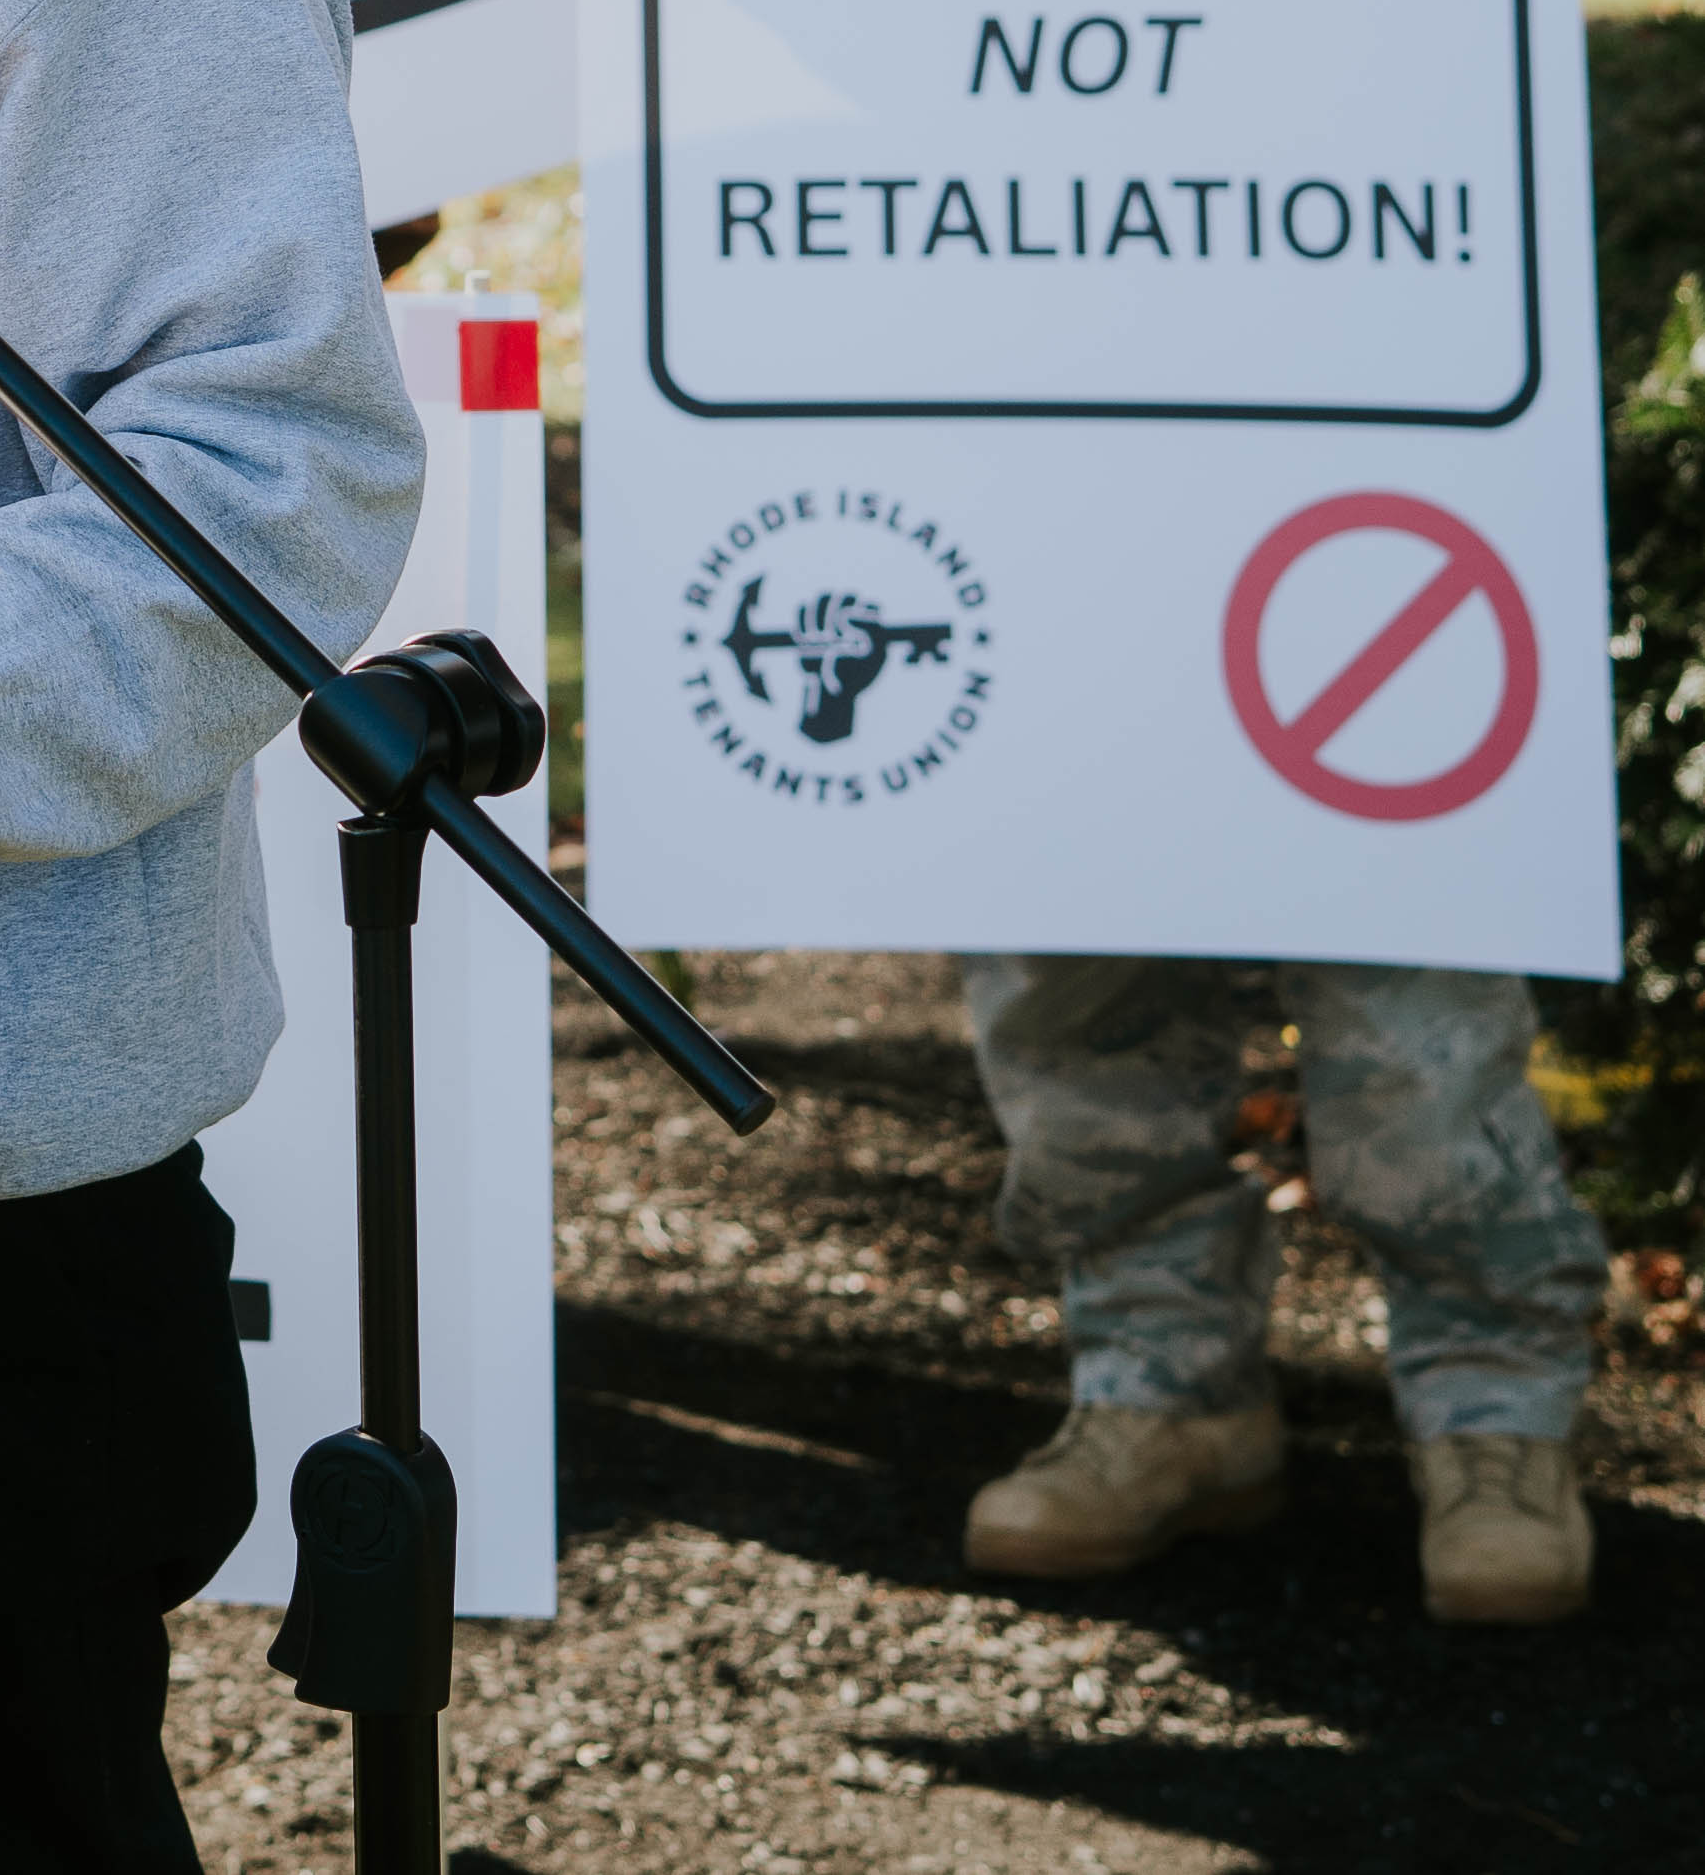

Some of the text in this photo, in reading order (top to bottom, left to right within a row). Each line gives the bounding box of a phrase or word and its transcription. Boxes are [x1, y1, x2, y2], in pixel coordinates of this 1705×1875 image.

[970, 16, 1204, 96] NOT
[719, 179, 1473, 264] RETALIATION!
[684, 492, 988, 610] RHODE ISLAND
[684, 669, 992, 804] TENANTS UNION
